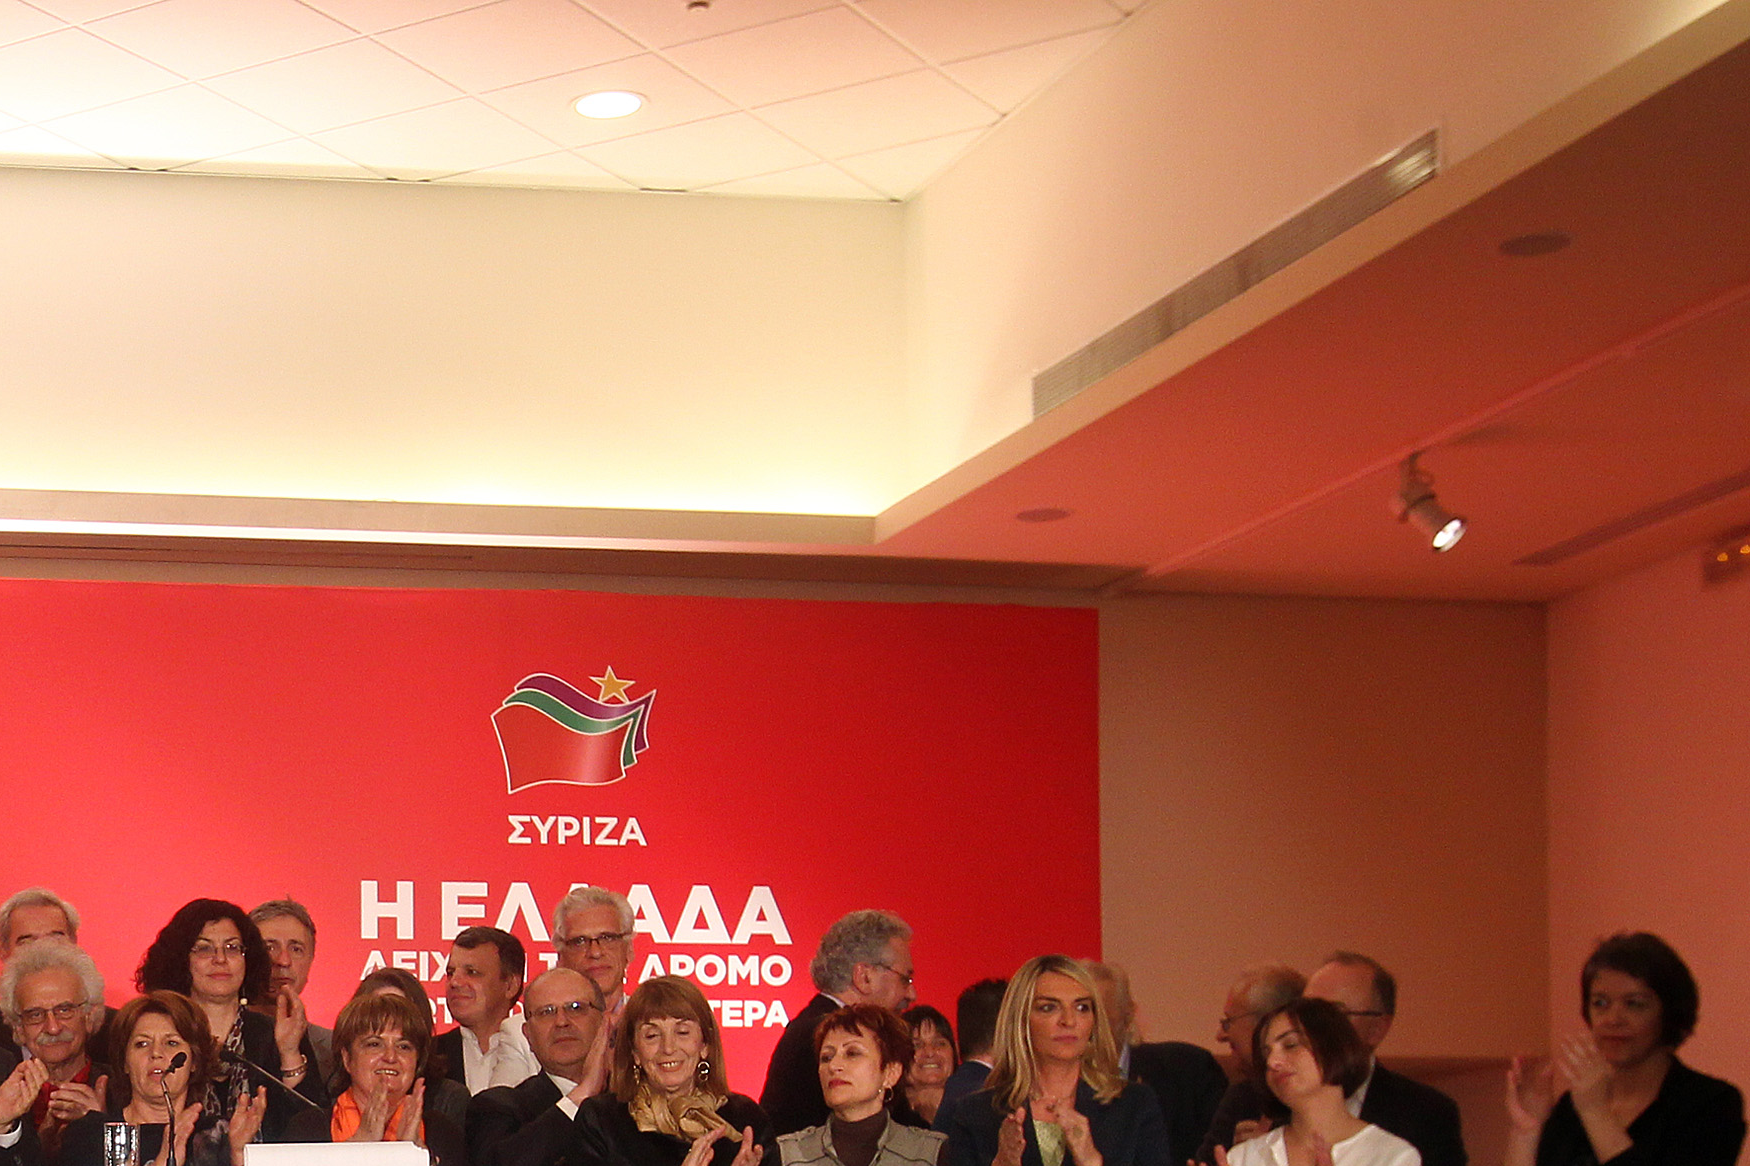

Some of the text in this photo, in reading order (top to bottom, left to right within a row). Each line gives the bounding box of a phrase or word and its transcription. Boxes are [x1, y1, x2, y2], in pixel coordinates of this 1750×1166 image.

[507, 814, 648, 847] ΣΥΡΙΖΑ
[360, 880, 793, 946] Η ΕΛΑΔΑ
